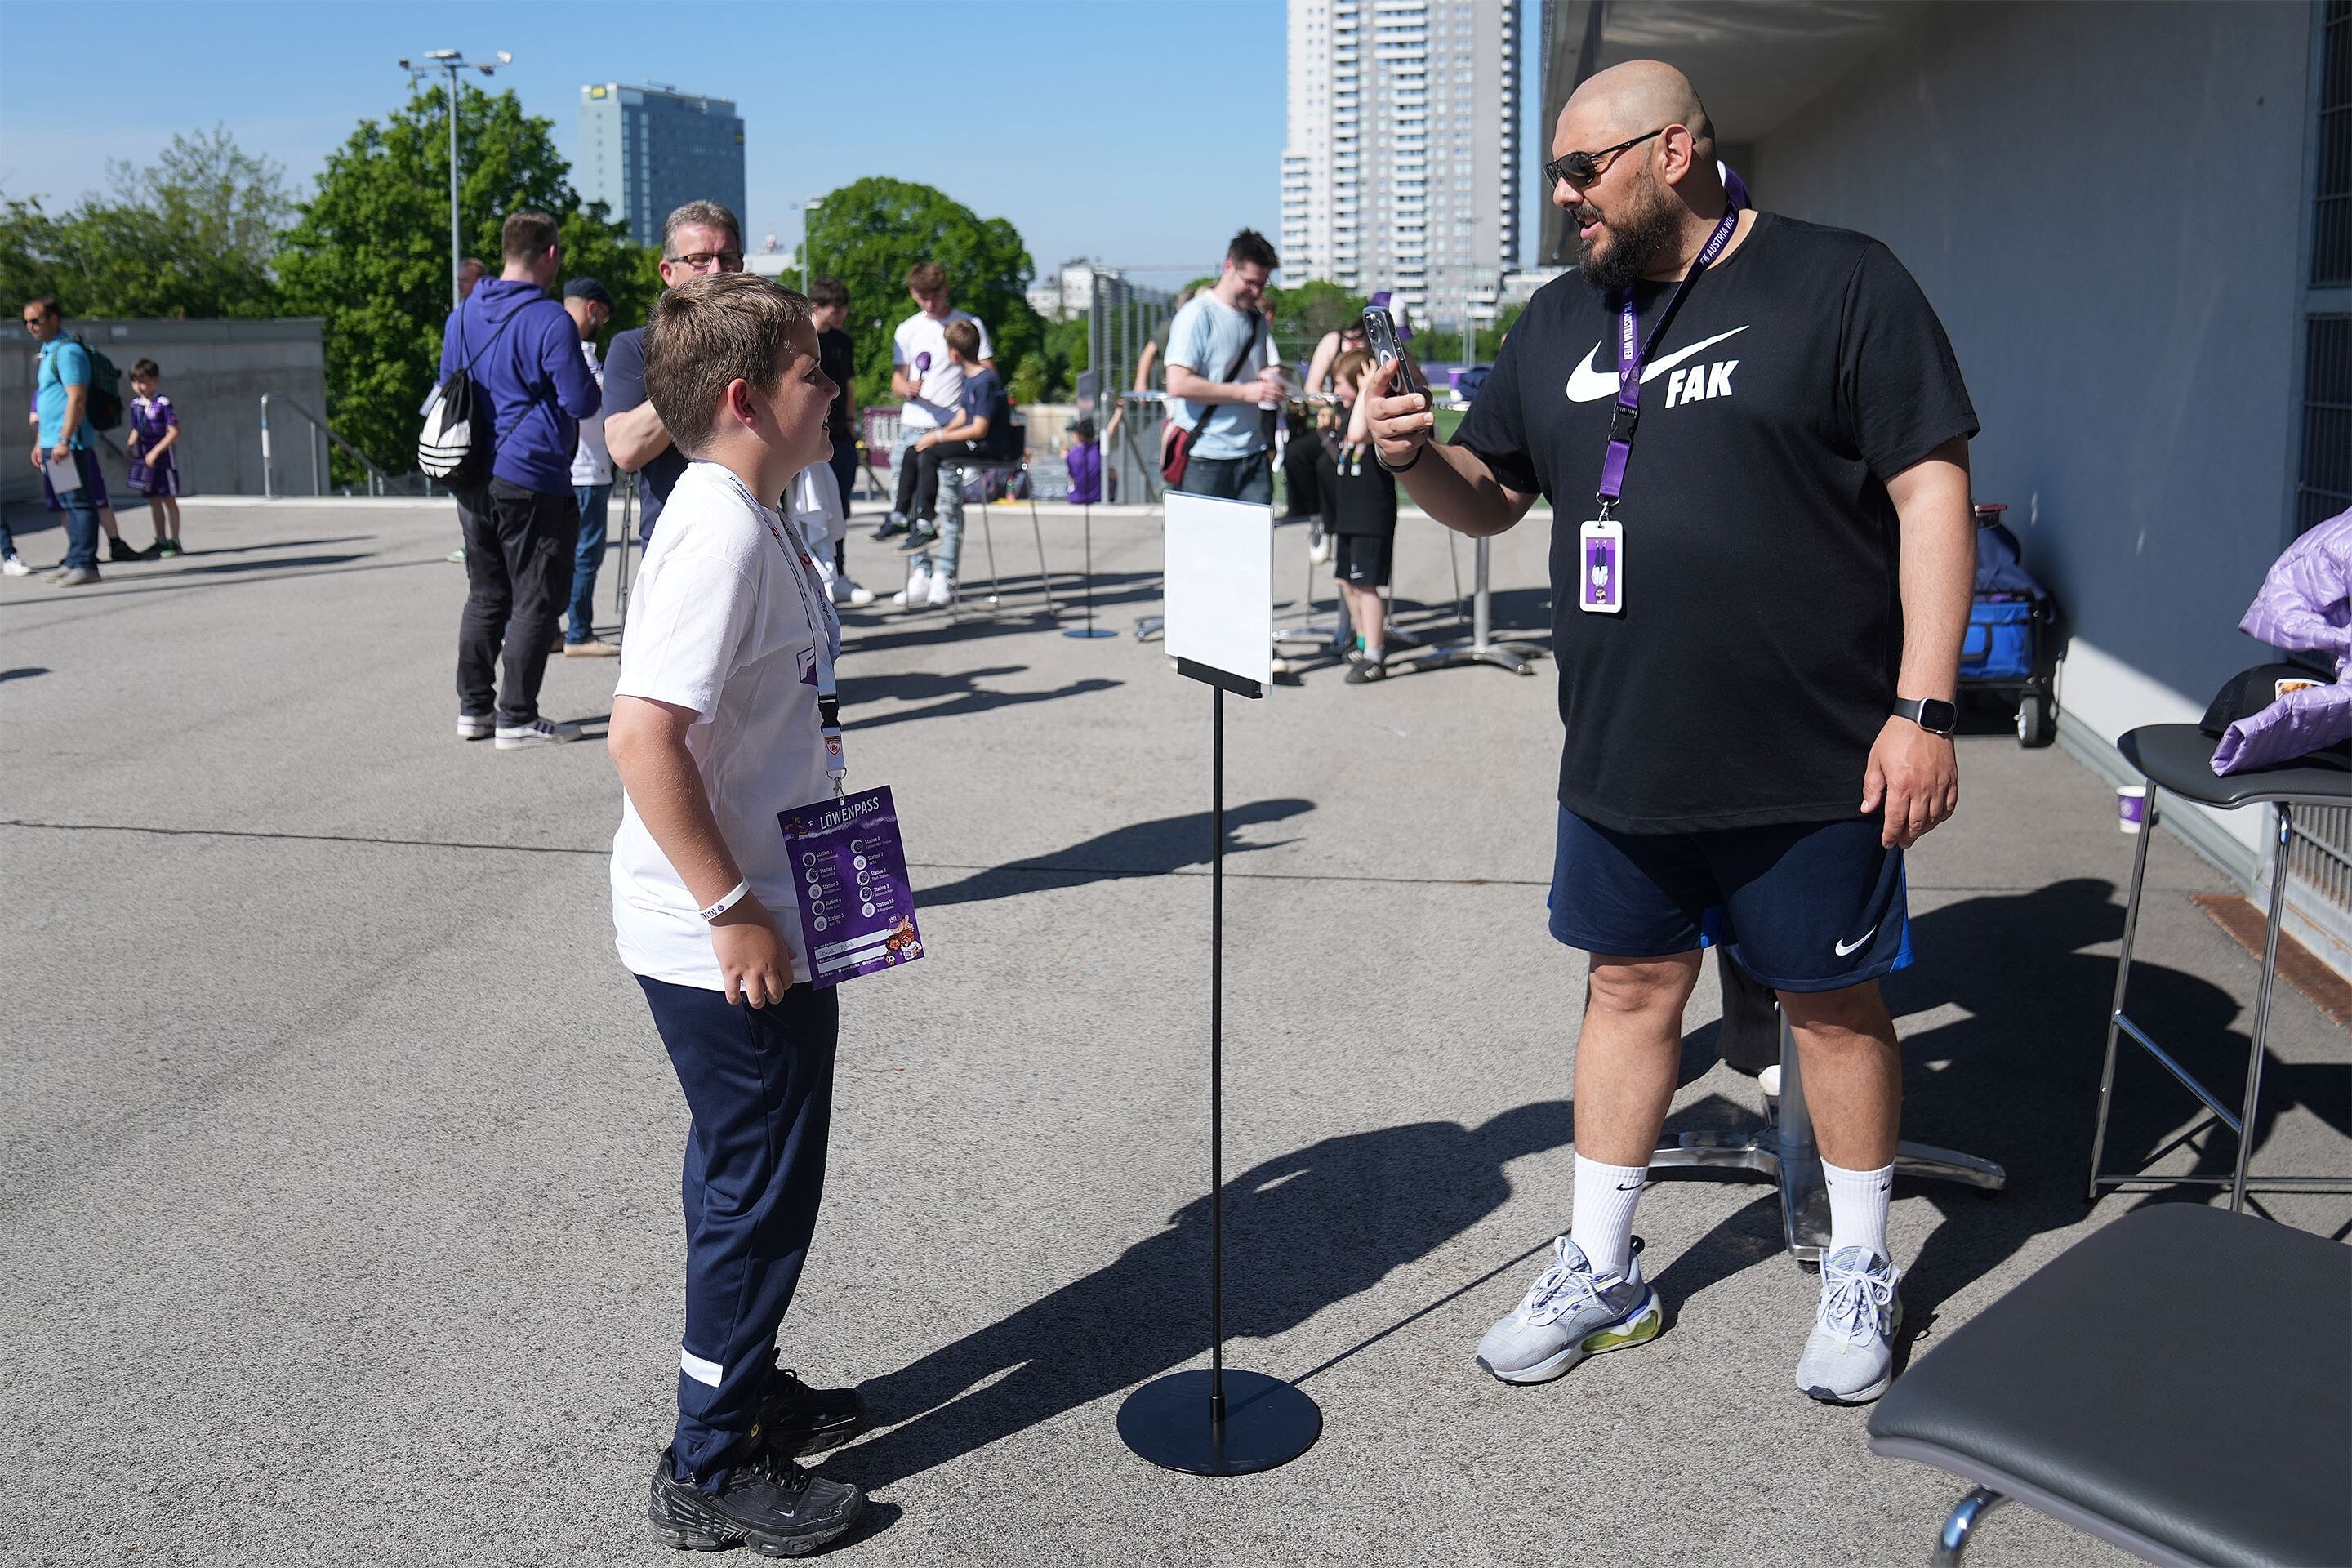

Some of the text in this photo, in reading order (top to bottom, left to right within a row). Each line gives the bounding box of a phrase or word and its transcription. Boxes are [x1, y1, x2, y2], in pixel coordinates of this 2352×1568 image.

[1699, 253, 1710, 266] FK
[1707, 226, 1729, 257] AUSTRIA
[1624, 301, 1633, 313] FK
[1624, 340, 1633, 360] WIEN
[1665, 359, 1740, 409] FAK
[820, 796, 880, 830] LÖWENPASS
[822, 882, 835, 890] Station
[825, 898, 838, 906] Station
[875, 900, 889, 908] Station
